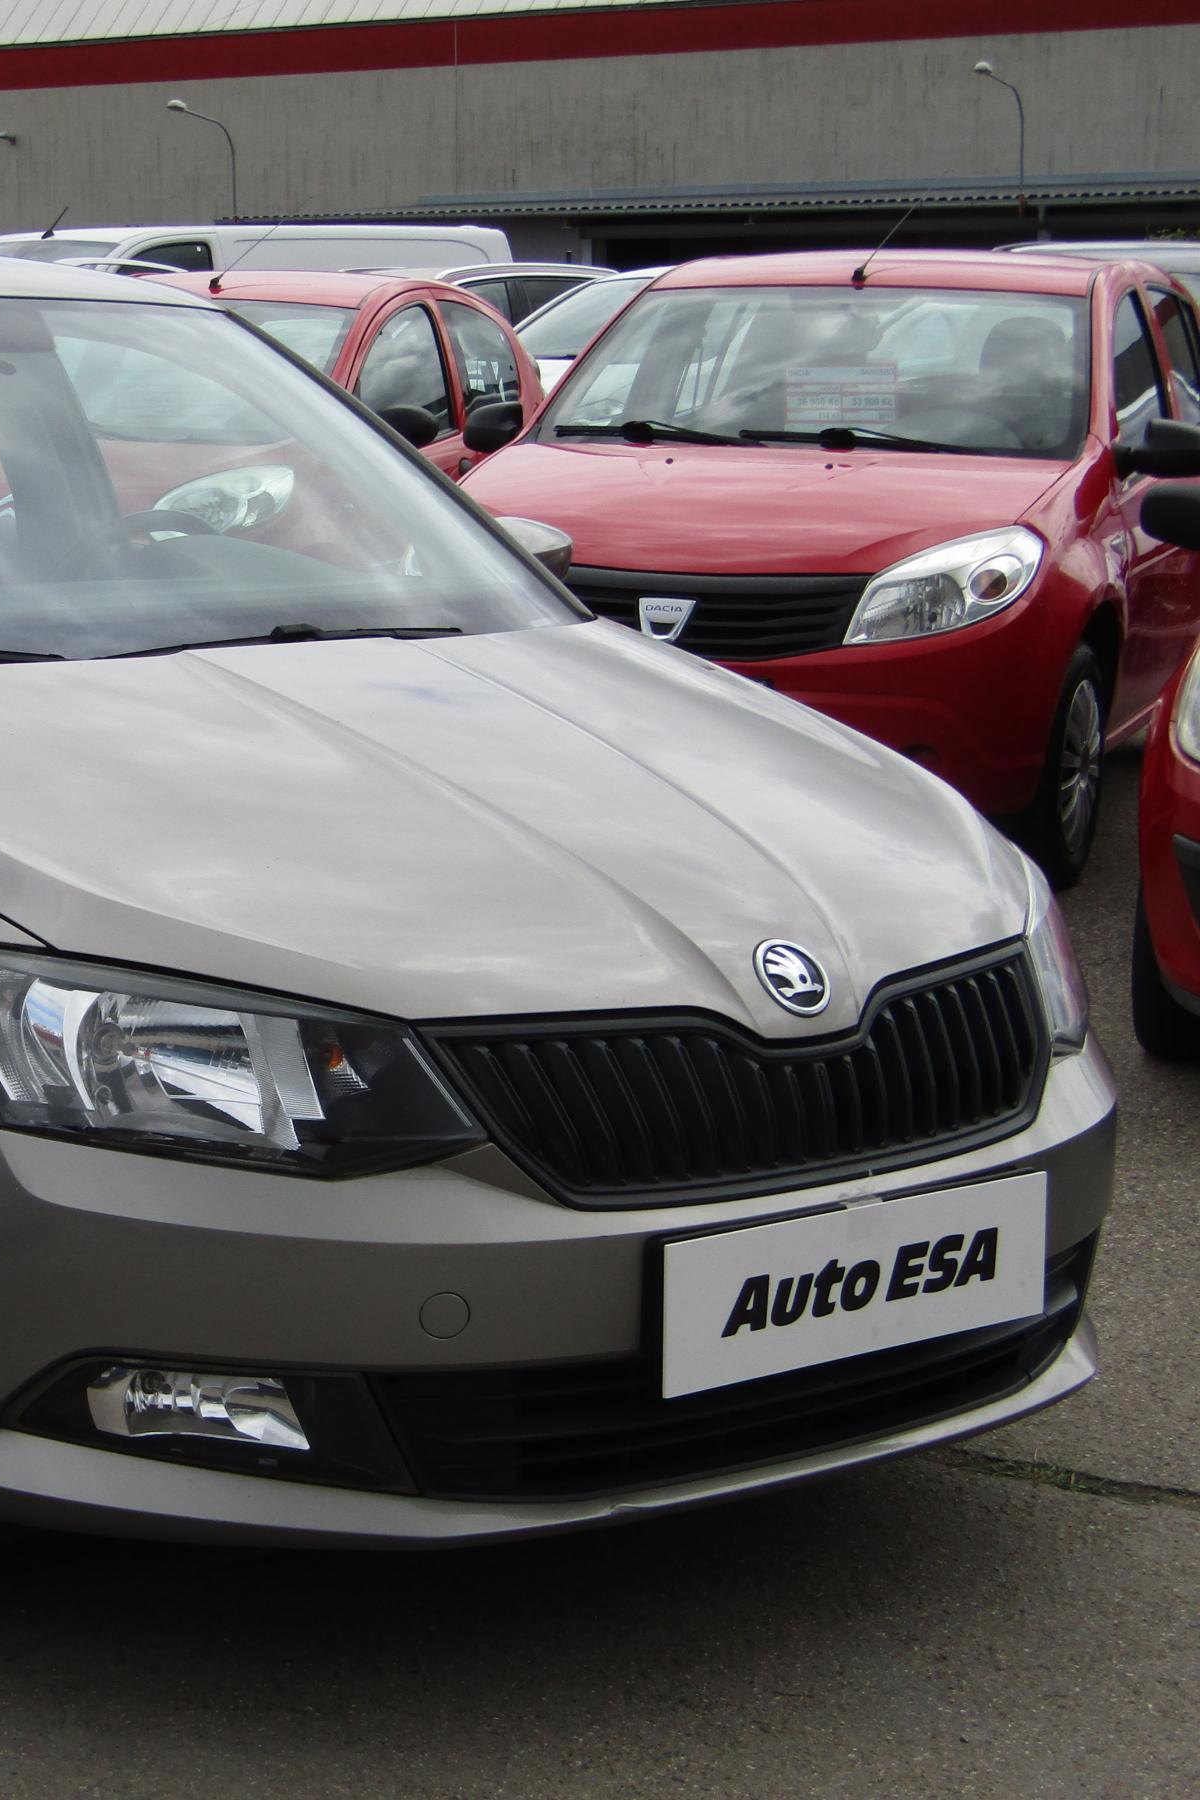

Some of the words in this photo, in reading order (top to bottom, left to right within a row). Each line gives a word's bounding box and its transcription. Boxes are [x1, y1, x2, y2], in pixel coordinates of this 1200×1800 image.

[645, 604, 682, 612] DACIA
[720, 1258, 881, 1338] Auto
[885, 1226, 999, 1302] ESA
